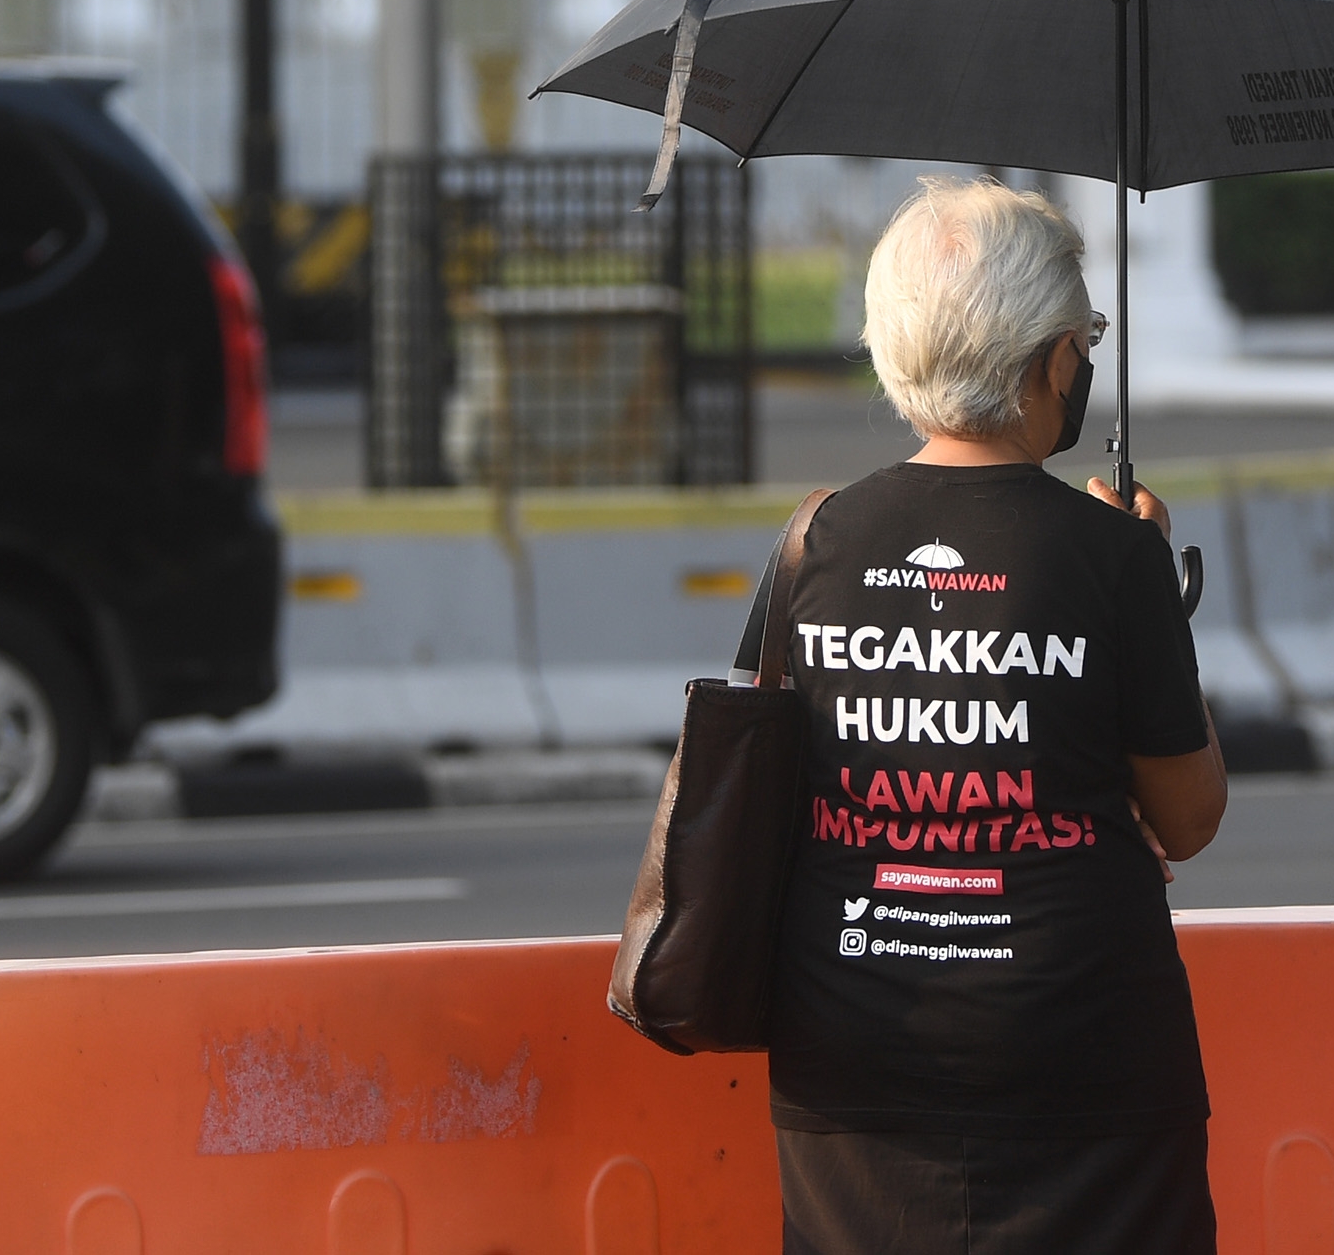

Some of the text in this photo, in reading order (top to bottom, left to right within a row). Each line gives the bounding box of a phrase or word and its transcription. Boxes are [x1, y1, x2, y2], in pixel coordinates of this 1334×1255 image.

[863, 568, 1007, 592] #SAYAWAWAN
[798, 623, 1087, 678] TEGAKKAN
[836, 696, 1029, 744] HUKUM
[841, 767, 1034, 814] LAWAN
[812, 796, 1096, 852] IMPUNITAS!
[881, 871, 997, 888] sayawawan.com
[873, 905, 1011, 927] @dipanggilwawan
[870, 939, 1013, 960] @dipanggilwawan
